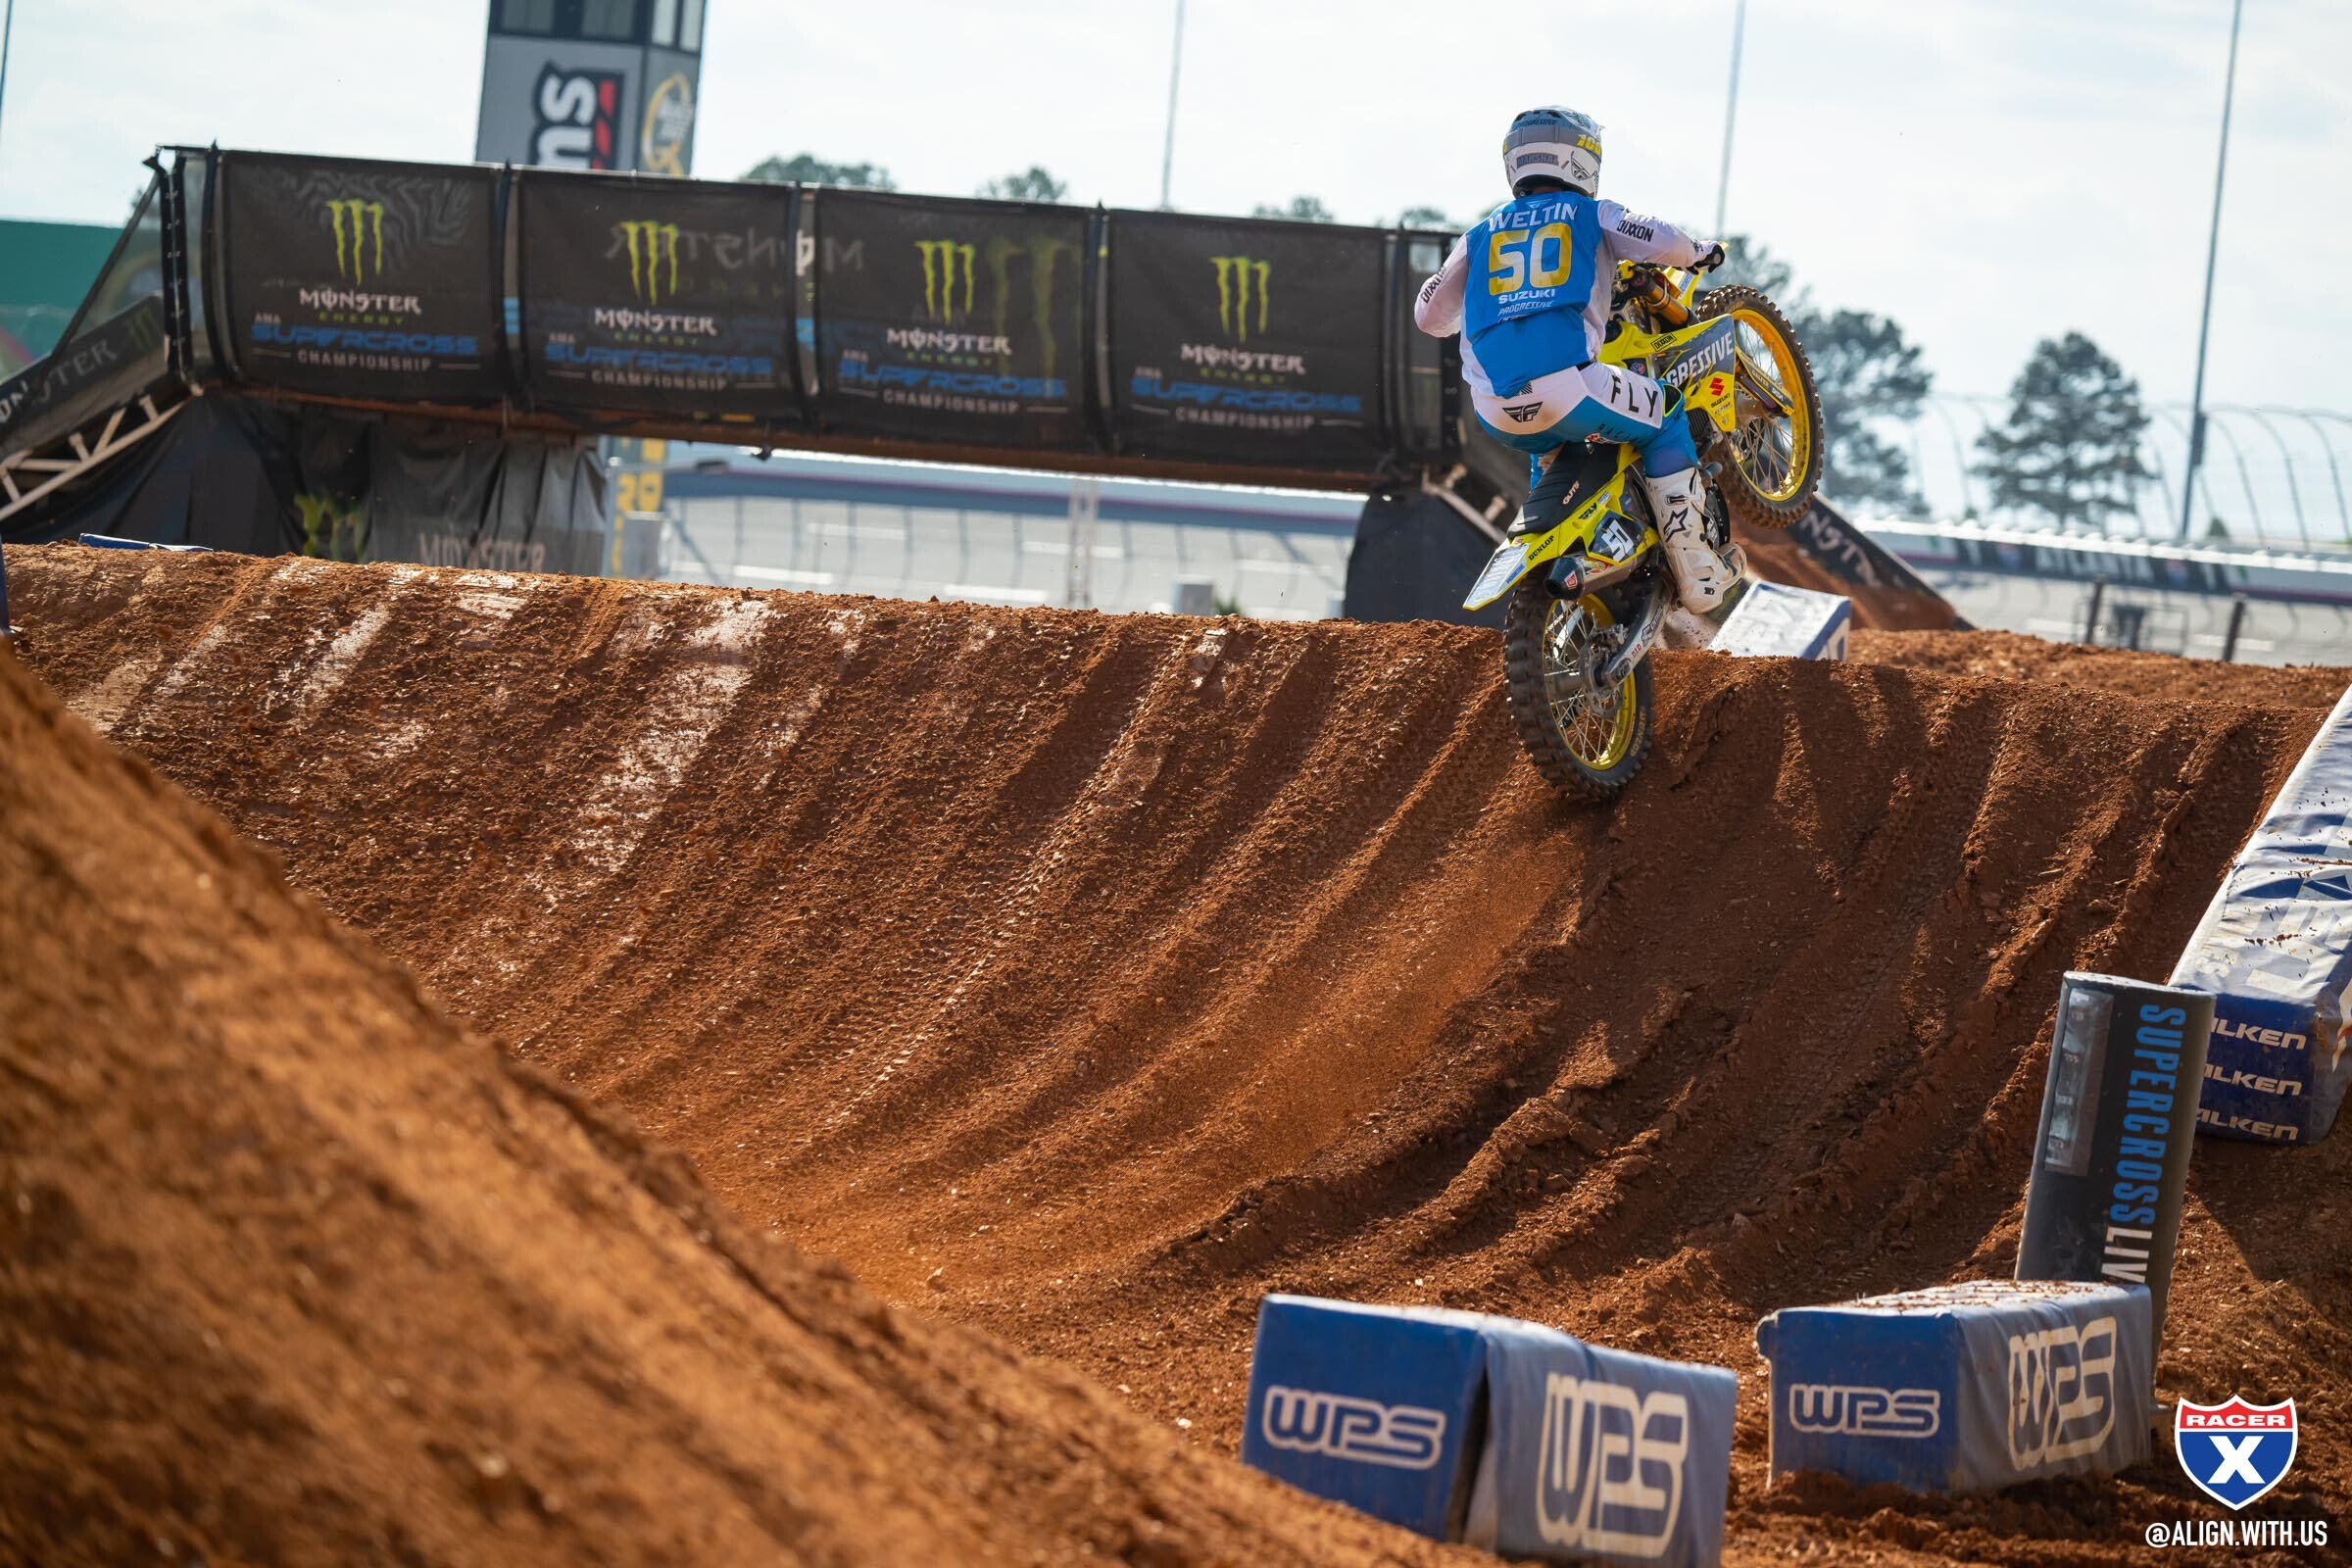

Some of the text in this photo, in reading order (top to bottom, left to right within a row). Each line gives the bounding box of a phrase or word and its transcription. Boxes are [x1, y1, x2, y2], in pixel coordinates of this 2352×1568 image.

[1489, 203, 1578, 231] WELTIN
[1616, 220, 1654, 242] DIXXON
[1489, 221, 1572, 296] 50
[299, 287, 422, 316] MONSTER
[1497, 300, 1555, 317] PROGRESSIVE
[1498, 289, 1556, 305] SUZUKI
[594, 307, 717, 335] MONSTER
[887, 327, 1012, 356] MONSTER
[297, 349, 432, 372] CHAMPIONSHIP
[1181, 343, 1306, 375] MONSTER
[1666, 332, 1735, 387] GRESSIVE
[591, 369, 727, 391] CHAMPIONSHIP
[1610, 374, 1658, 418] FLY
[1528, 535, 1555, 562] DUNLOP
[2211, 1017, 2307, 1051] LKEN
[2007, 1316, 2117, 1472] WPS
[1788, 1383, 1940, 1439] WPS
[1261, 1385, 1446, 1470] WPS
[1536, 1372, 1689, 1559] WPS
